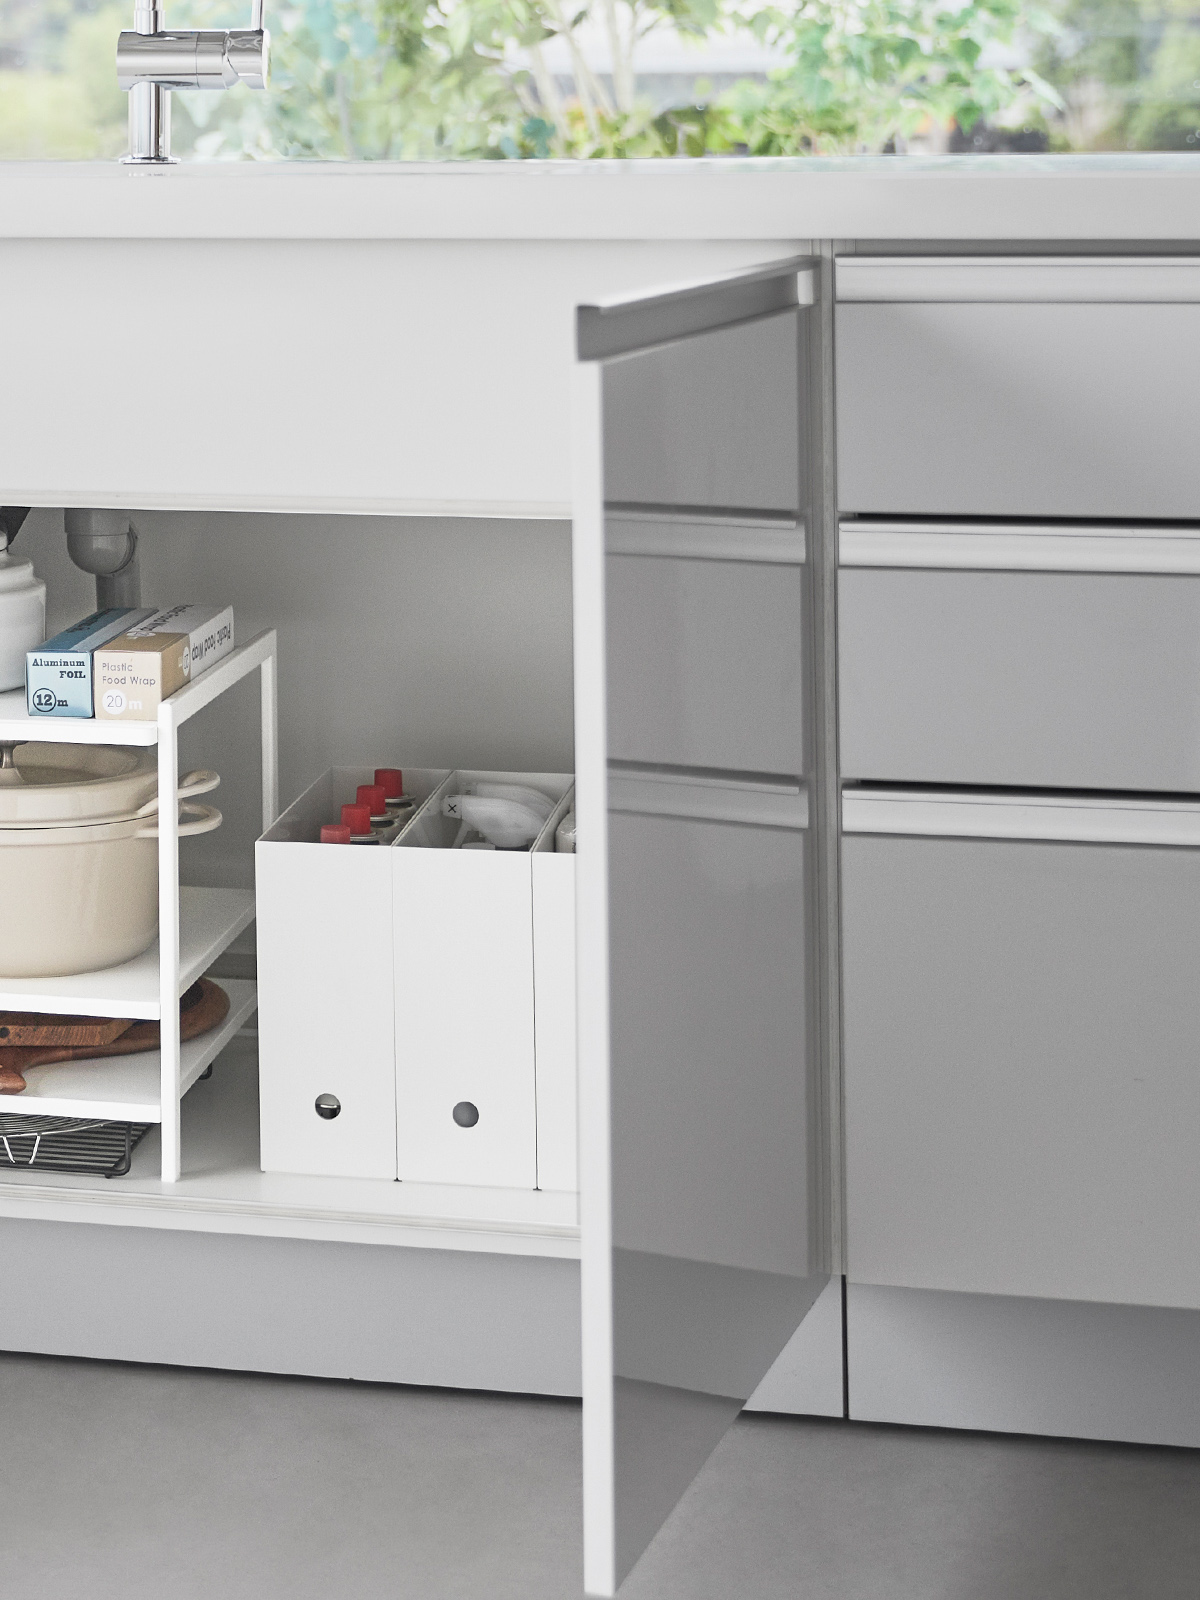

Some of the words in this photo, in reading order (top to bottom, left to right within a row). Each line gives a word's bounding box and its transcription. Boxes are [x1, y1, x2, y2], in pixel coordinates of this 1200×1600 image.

[32, 658, 86, 667] Aluminum
[102, 662, 133, 672] Plastic
[59, 671, 86, 679] FOIL
[102, 676, 127, 685] Food
[130, 676, 156, 687] Wrap
